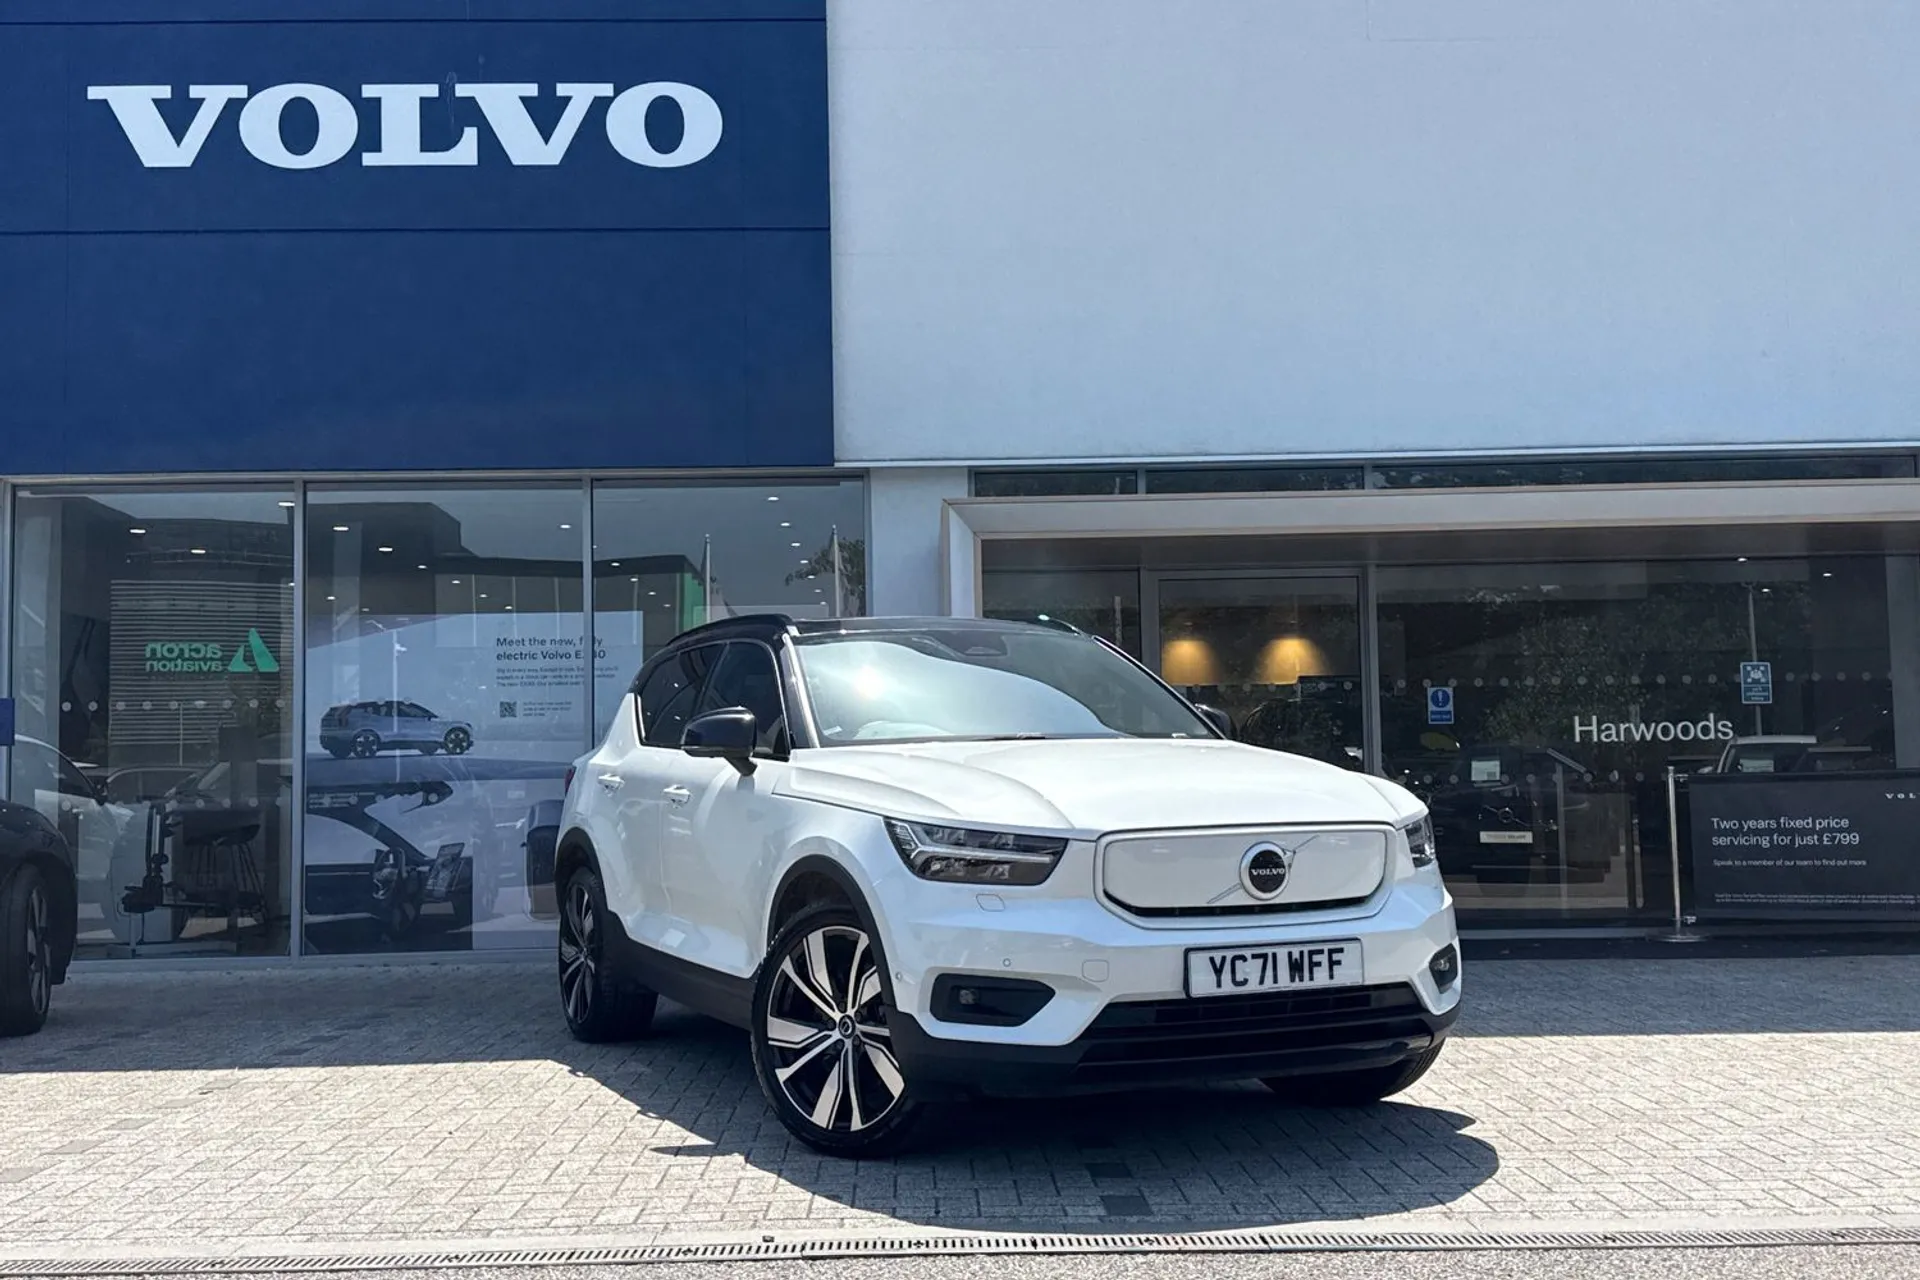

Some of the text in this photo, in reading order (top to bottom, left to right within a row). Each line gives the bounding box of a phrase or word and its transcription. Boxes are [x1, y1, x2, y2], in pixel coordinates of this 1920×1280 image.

[87, 81, 723, 169] VOLVO
[496, 637, 526, 647] Meet
[528, 636, 547, 646] the
[549, 637, 576, 648] new,
[496, 650, 538, 661] electric
[540, 650, 572, 660] Volvo
[1574, 712, 1734, 743] Harwoods
[1885, 792, 1920, 800] VOL
[1711, 816, 1850, 832] Two years fixed price
[1711, 832, 1861, 848] servicing for just £799
[1251, 867, 1286, 876] VOLVO
[1209, 947, 1345, 989] YC71 WFF
